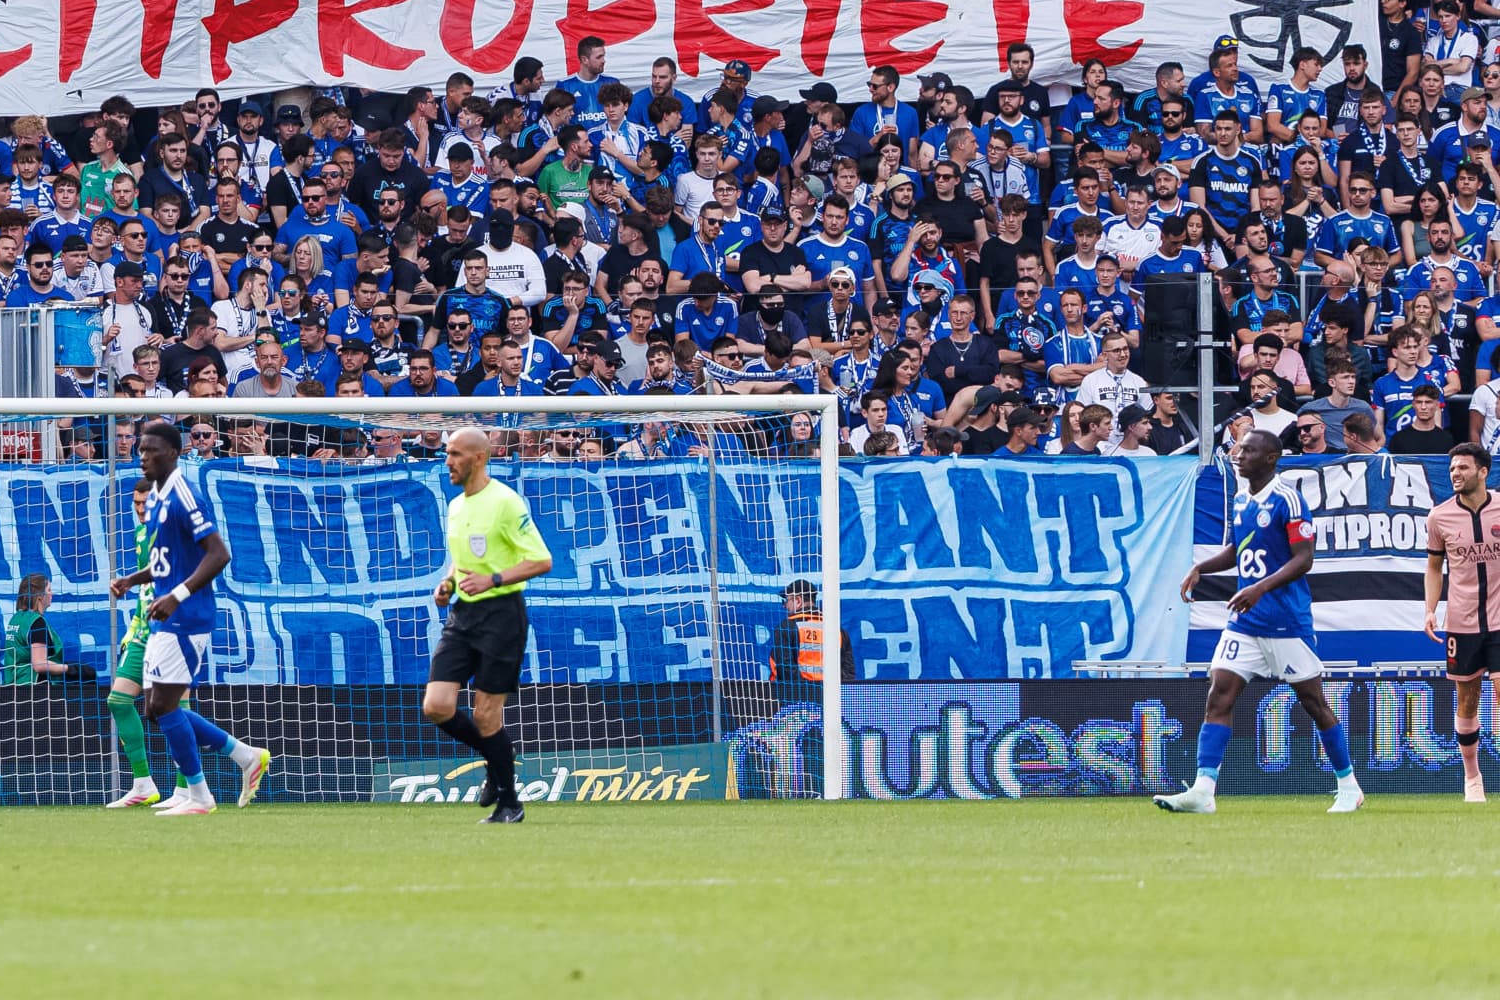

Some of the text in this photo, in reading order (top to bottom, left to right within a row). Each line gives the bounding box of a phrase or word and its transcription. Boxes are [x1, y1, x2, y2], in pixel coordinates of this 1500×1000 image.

[1209, 180, 1250, 193] WINAMAX
[1390, 461, 1434, 509] A
[218, 467, 1123, 588] INDPENDANT
[1239, 548, 1268, 579] es
[805, 628, 818, 641] 26
[1219, 638, 1241, 661] 19
[571, 766, 710, 801] Twist
